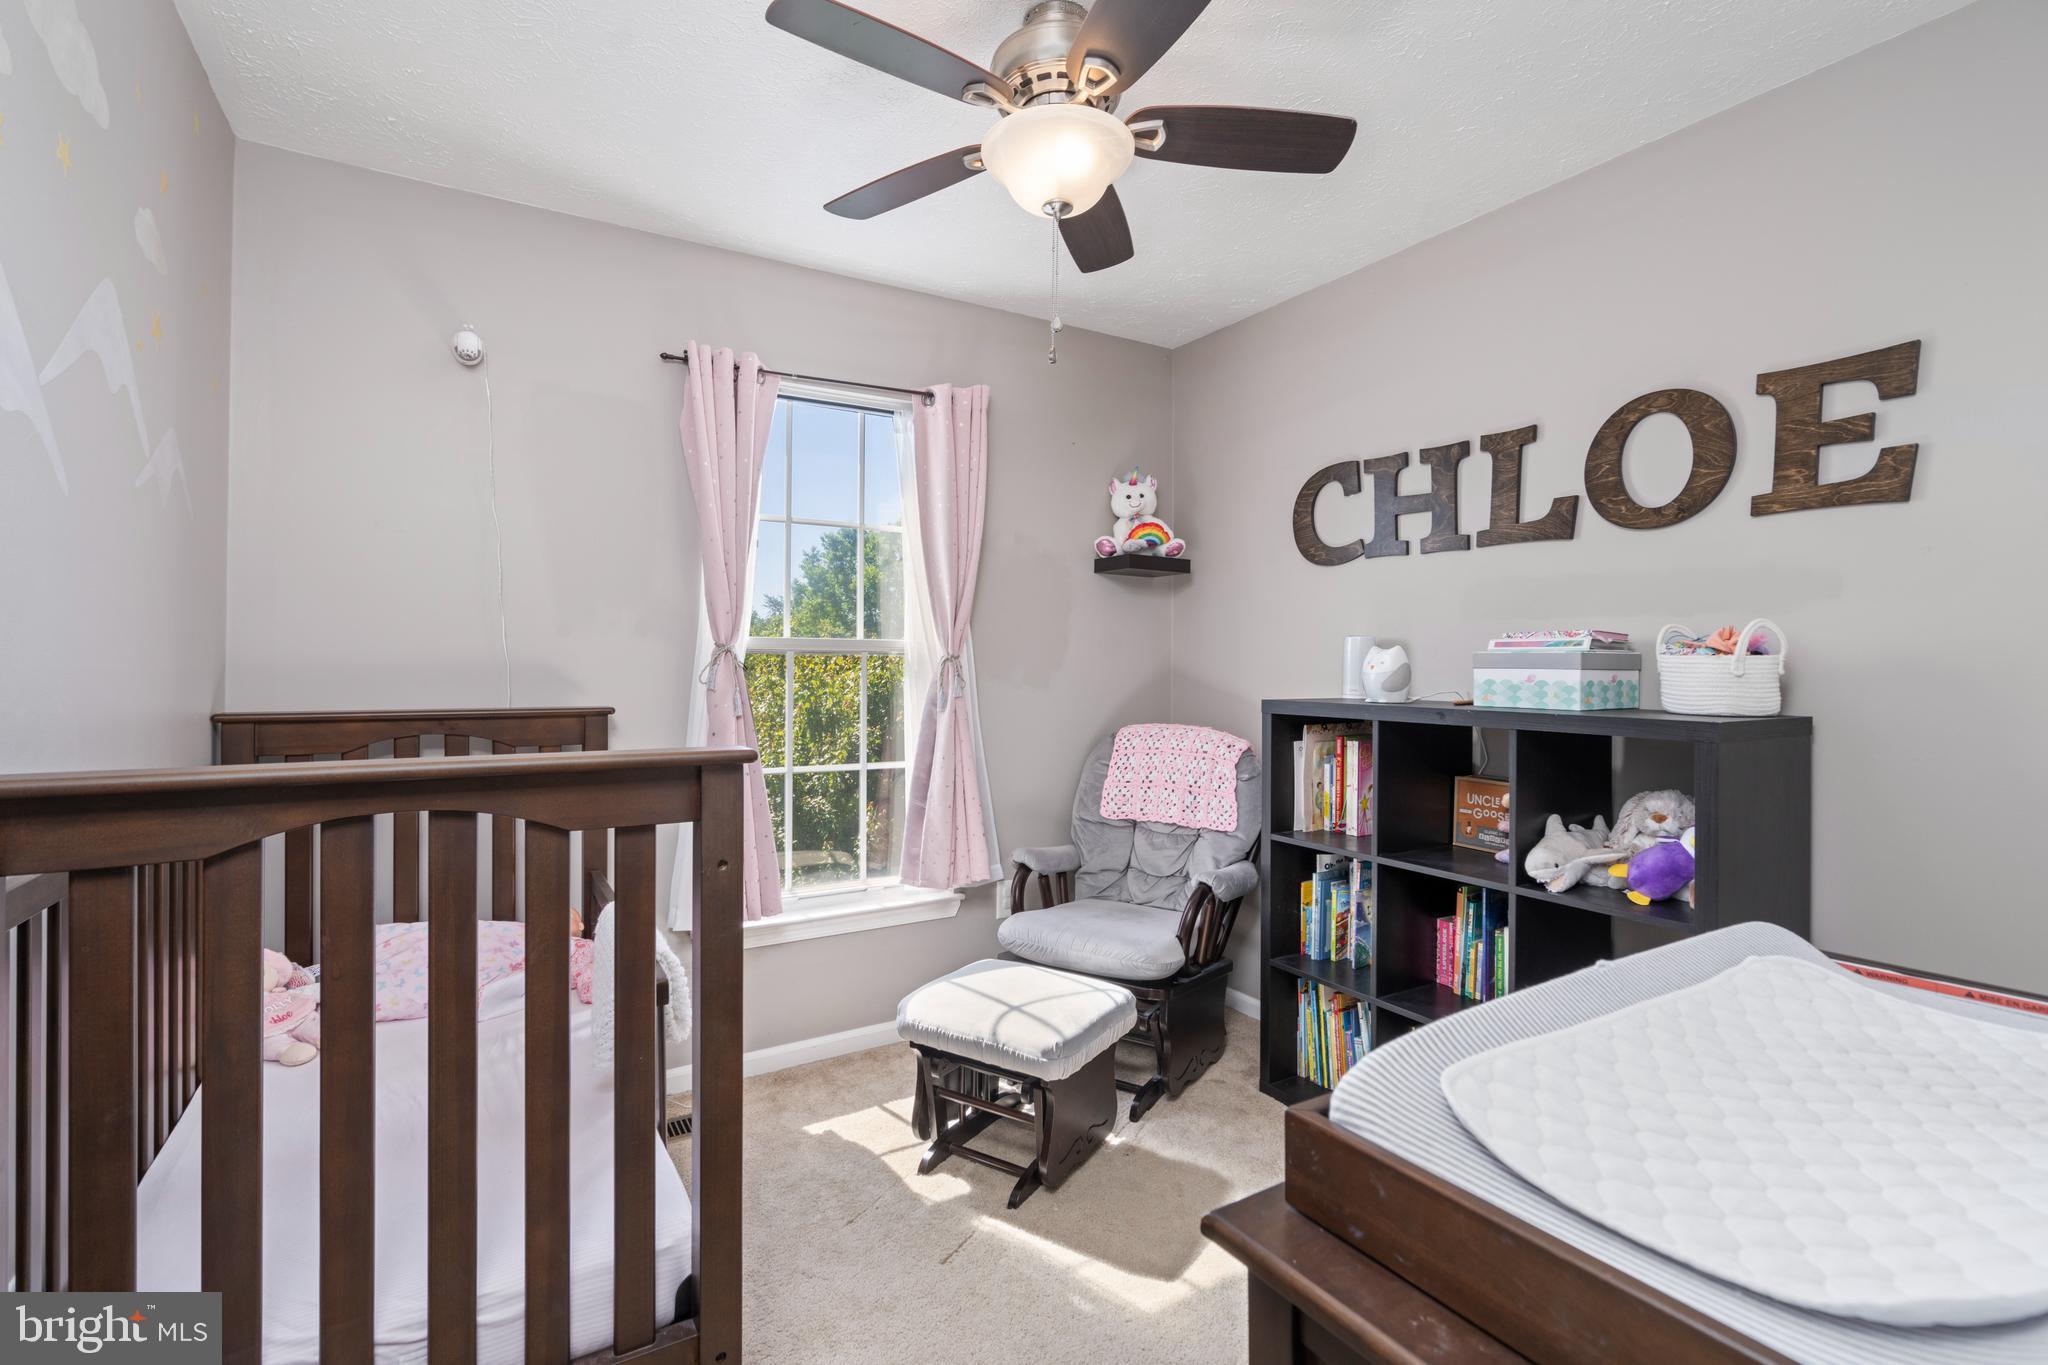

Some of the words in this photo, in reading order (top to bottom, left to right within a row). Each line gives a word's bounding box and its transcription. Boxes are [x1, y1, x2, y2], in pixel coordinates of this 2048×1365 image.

[1293, 339, 1922, 567] CHLOE
[1466, 792, 1502, 809] UNCLE
[1472, 807, 1510, 822] GOOSE
[1866, 971, 1909, 985] WARNING
[264, 995, 292, 1013] OLLY
[268, 1010, 293, 1024] hloe
